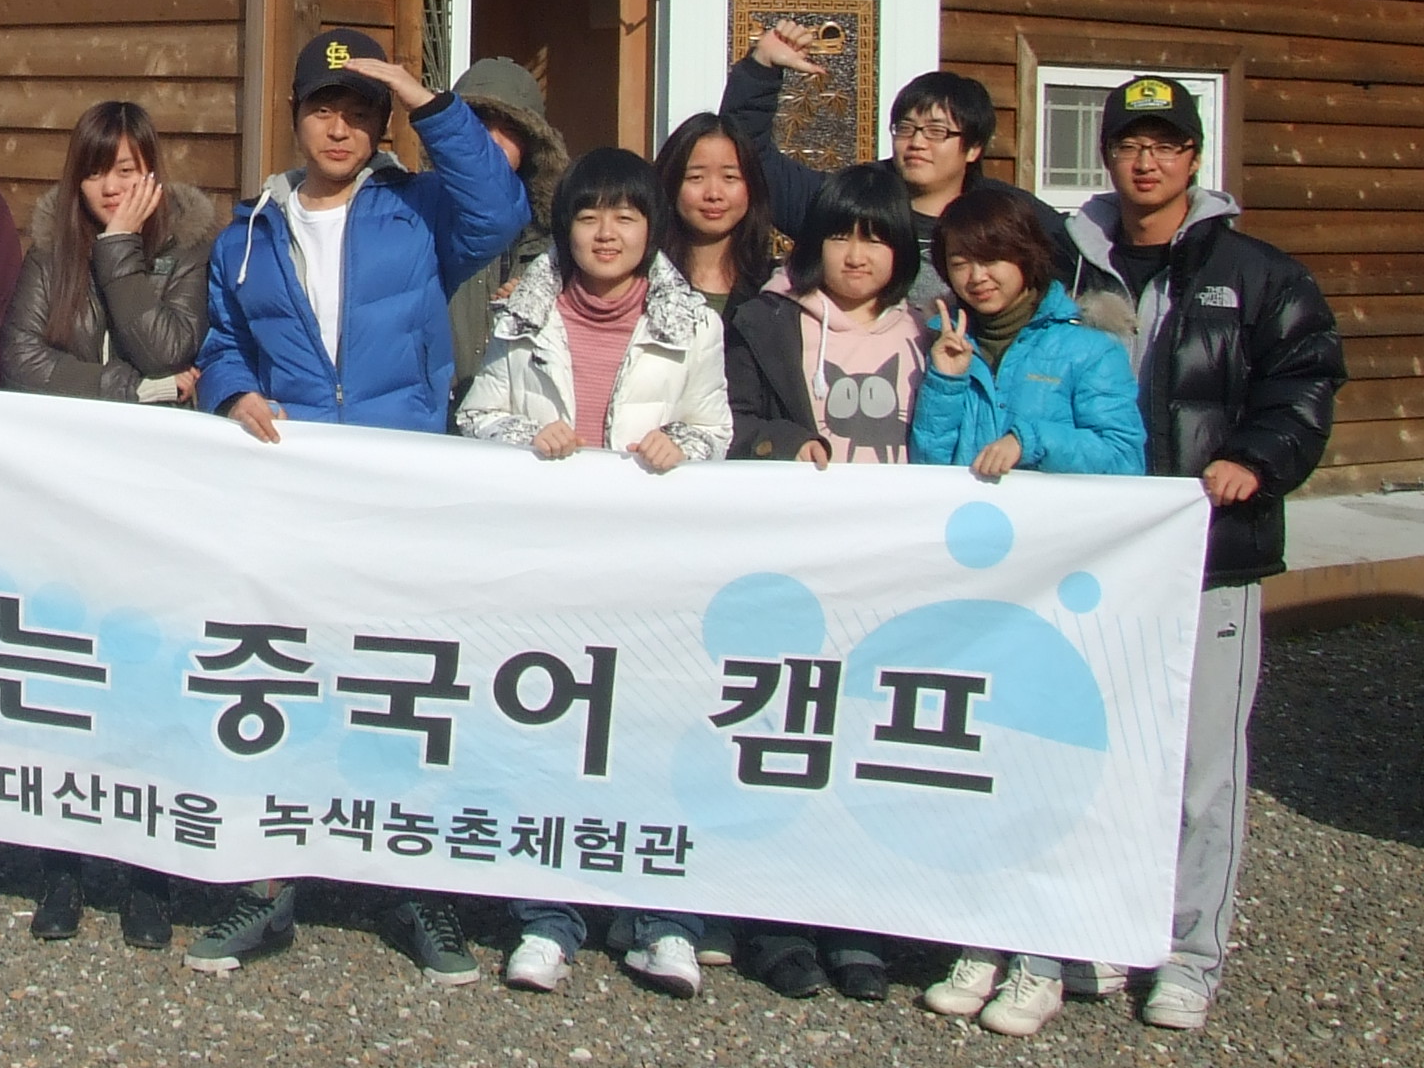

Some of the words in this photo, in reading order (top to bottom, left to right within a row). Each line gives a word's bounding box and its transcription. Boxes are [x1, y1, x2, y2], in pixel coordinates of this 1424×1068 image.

[188, 621, 618, 776] 중국어
[709, 659, 994, 793] 캠프
[260, 795, 696, 878] 녹색농촌체험관
